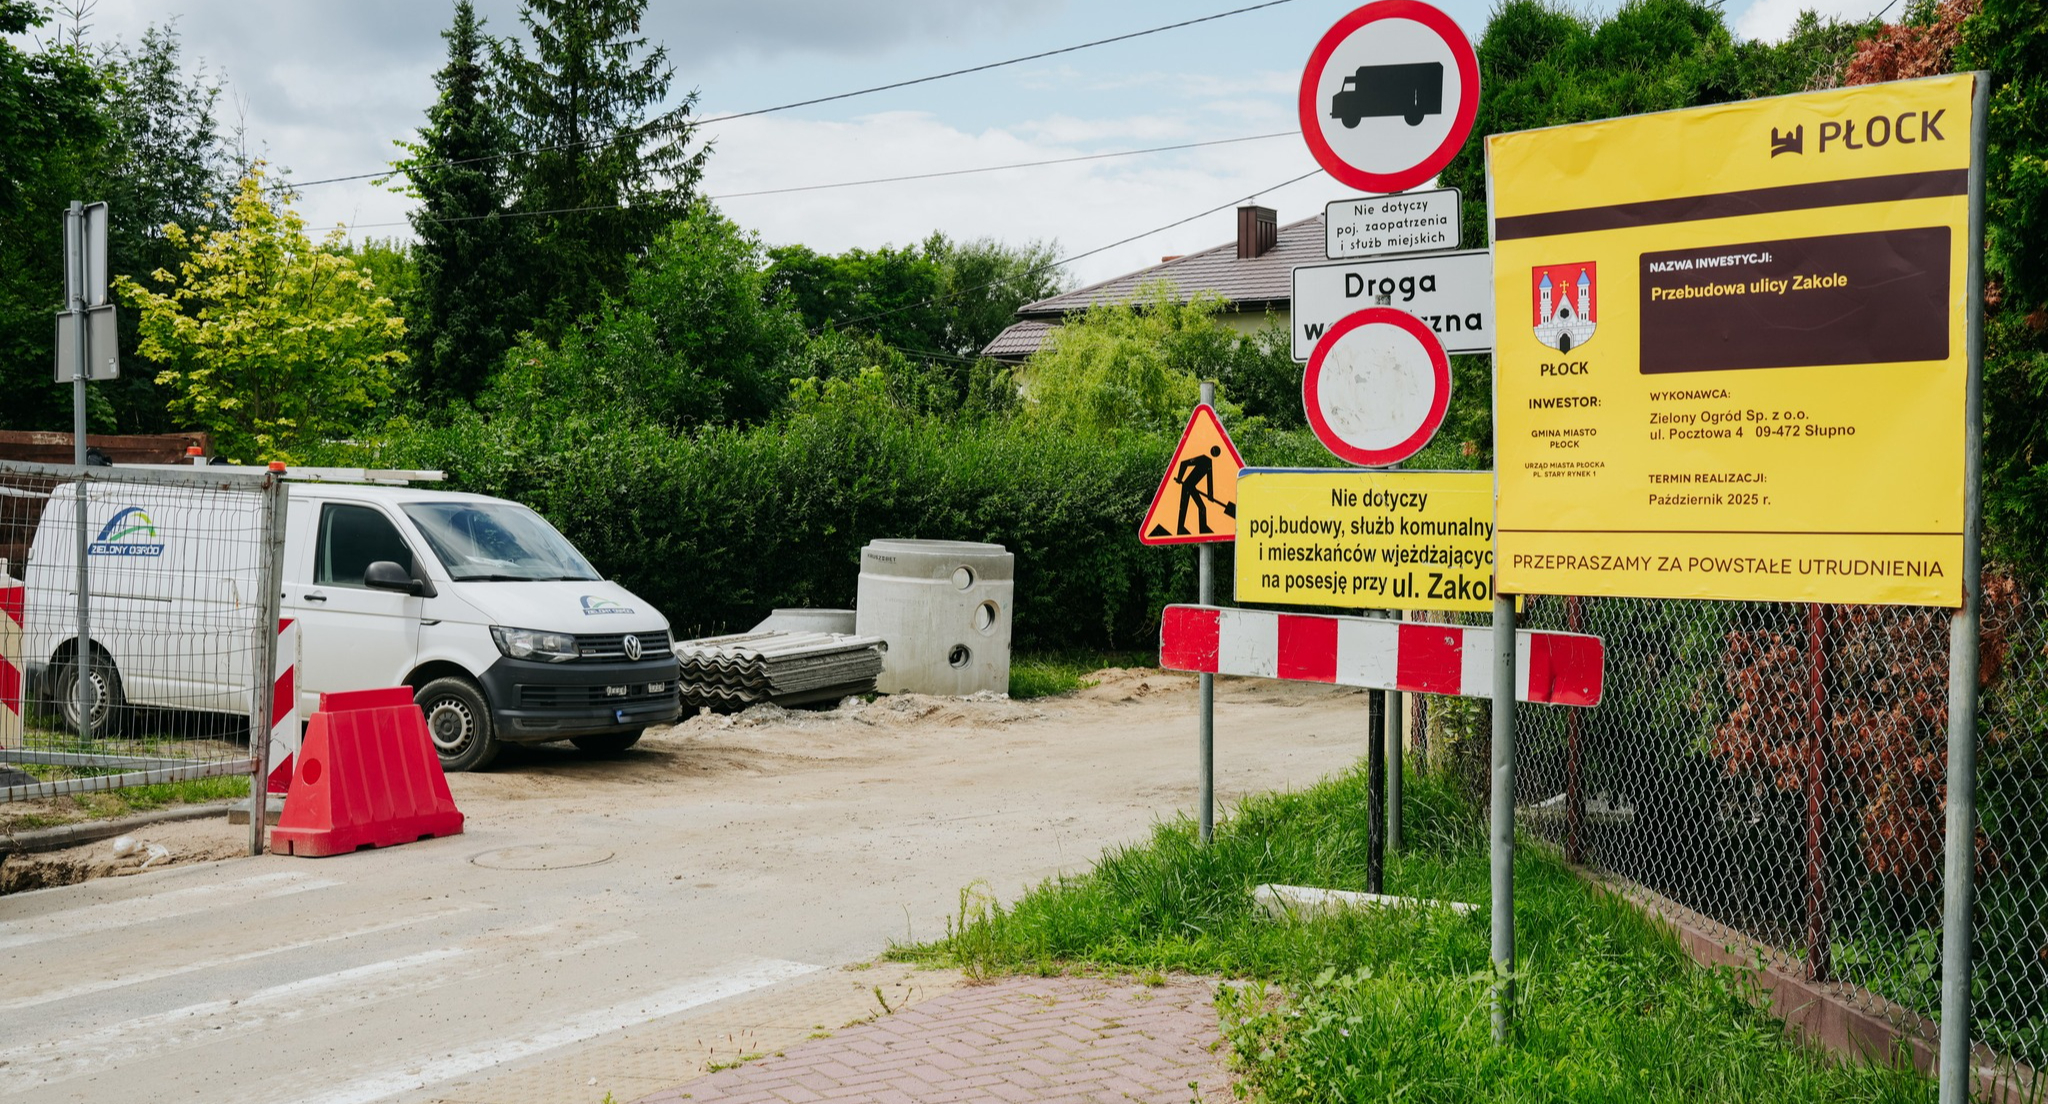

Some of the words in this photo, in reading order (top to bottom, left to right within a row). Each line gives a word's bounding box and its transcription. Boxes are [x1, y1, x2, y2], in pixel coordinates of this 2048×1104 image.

[1818, 108, 1946, 153] PŁOCK
[1354, 204, 1375, 216] Nie
[1381, 200, 1428, 213] dotyczy
[1336, 224, 1360, 238] poj.
[1365, 214, 1448, 233] zaopatrzenia
[1340, 240, 1344, 251] i
[1350, 237, 1382, 250] służb
[1387, 231, 1446, 247] miejskich
[1650, 258, 1693, 273] NAZWA
[1695, 252, 1773, 269] INWESTYCJI:
[1345, 273, 1436, 302] Droga
[1651, 282, 1746, 301] Przebudowa
[1750, 278, 1788, 295] ulicy
[1792, 272, 1848, 290] Zakole
[1540, 361, 1589, 377] PŁOCK
[1528, 396, 1602, 409] INWESTOR:
[1650, 389, 1731, 401] WYKONAWCA:
[1650, 412, 1697, 426] Zielony
[1700, 410, 1742, 425] Ogród
[1746, 409, 1768, 423] Sp.
[1772, 412, 1780, 420] z
[1783, 410, 1809, 420] o.o.
[1531, 429, 1561, 438] GMINA
[1563, 428, 1597, 437] MIASTO
[1650, 429, 1665, 440] ul.
[1669, 427, 1731, 440] Pocztowa
[1735, 426, 1744, 438] 4
[1755, 425, 1801, 438] 09-472
[1804, 424, 1856, 438] Słupno
[1550, 440, 1580, 449] PŁOCK
[1525, 463, 1548, 471] URZĄD
[1576, 461, 1605, 469] PŁOCKA
[1648, 474, 1691, 483] TERMIN
[1694, 473, 1767, 483] REALIZACJI:
[1331, 488, 1357, 507] Nie
[1363, 488, 1428, 512] dotyczy
[1649, 493, 1723, 505] Październik
[1727, 493, 1759, 505] 2025
[1763, 495, 1771, 505] r.
[1250, 515, 1345, 538] poj.budowy,
[1350, 515, 1394, 535] służb
[1400, 517, 1493, 541] komunalny
[91, 545, 128, 554] ZIELONY
[1259, 543, 1263, 561] i
[1268, 543, 1377, 563] mieszkańców
[1382, 543, 1493, 570] wjeżdżającyc
[1513, 553, 1652, 571] PRZEPRASZAMY
[1658, 556, 1683, 573] ZA
[1688, 557, 1792, 575] POWSTAŁE
[1798, 559, 1944, 578] UTRUDNIENIA
[1262, 573, 1280, 588] na
[1285, 571, 1347, 593] posesję
[1352, 573, 1388, 594] przy
[1392, 572, 1420, 598] ul.
[1427, 573, 1493, 601] Zakol
